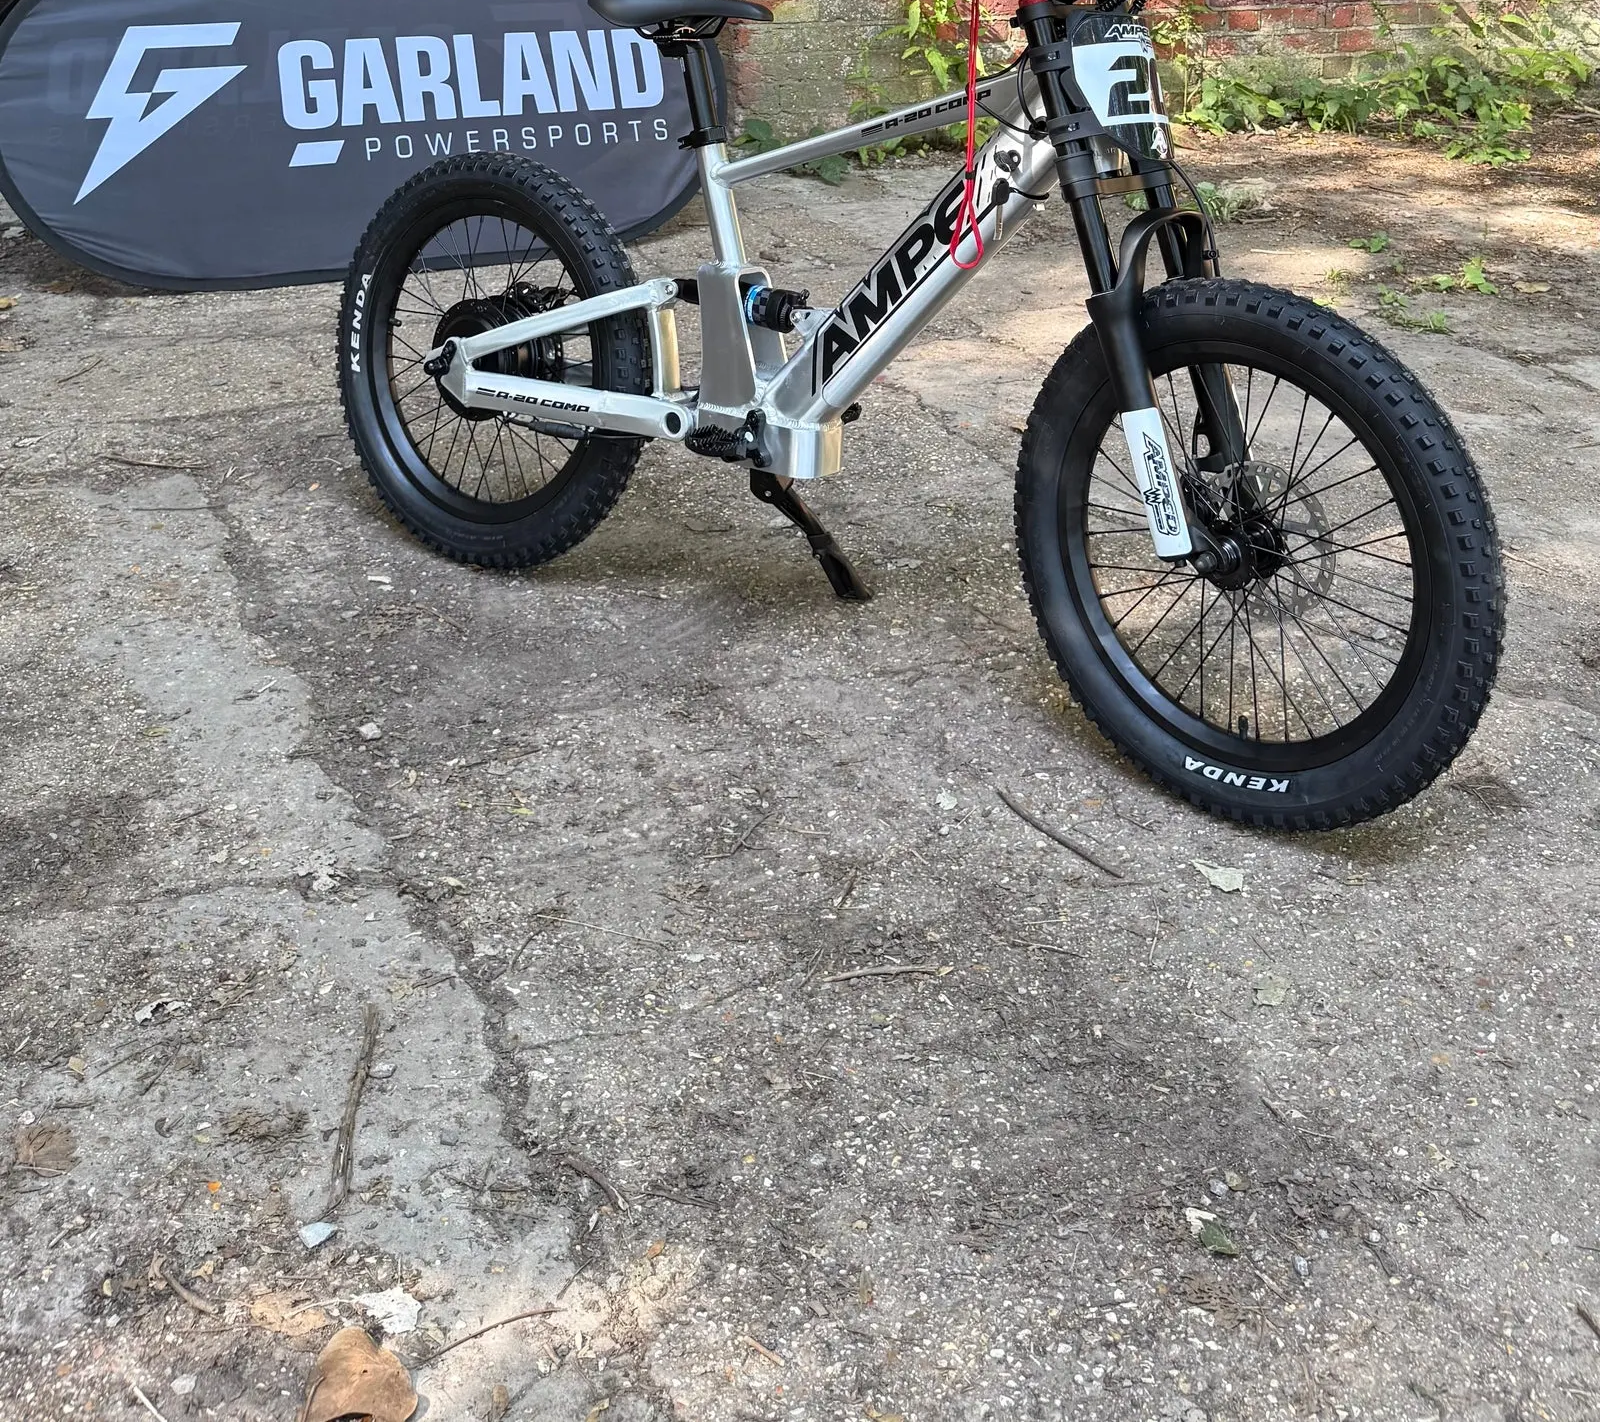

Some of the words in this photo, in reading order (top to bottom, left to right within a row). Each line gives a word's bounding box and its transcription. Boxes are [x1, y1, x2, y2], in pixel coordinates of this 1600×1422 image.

[277, 28, 665, 130] GARLAND
[365, 118, 669, 162] POWERSPORTS
[885, 107, 932, 130] A-20
[822, 162, 978, 385] AMPE
[350, 273, 373, 373] KENDA
[495, 390, 539, 405] A-20
[540, 398, 591, 413] COMP
[1145, 436, 1179, 534] AMPED
[1184, 755, 1290, 793] KENDA
